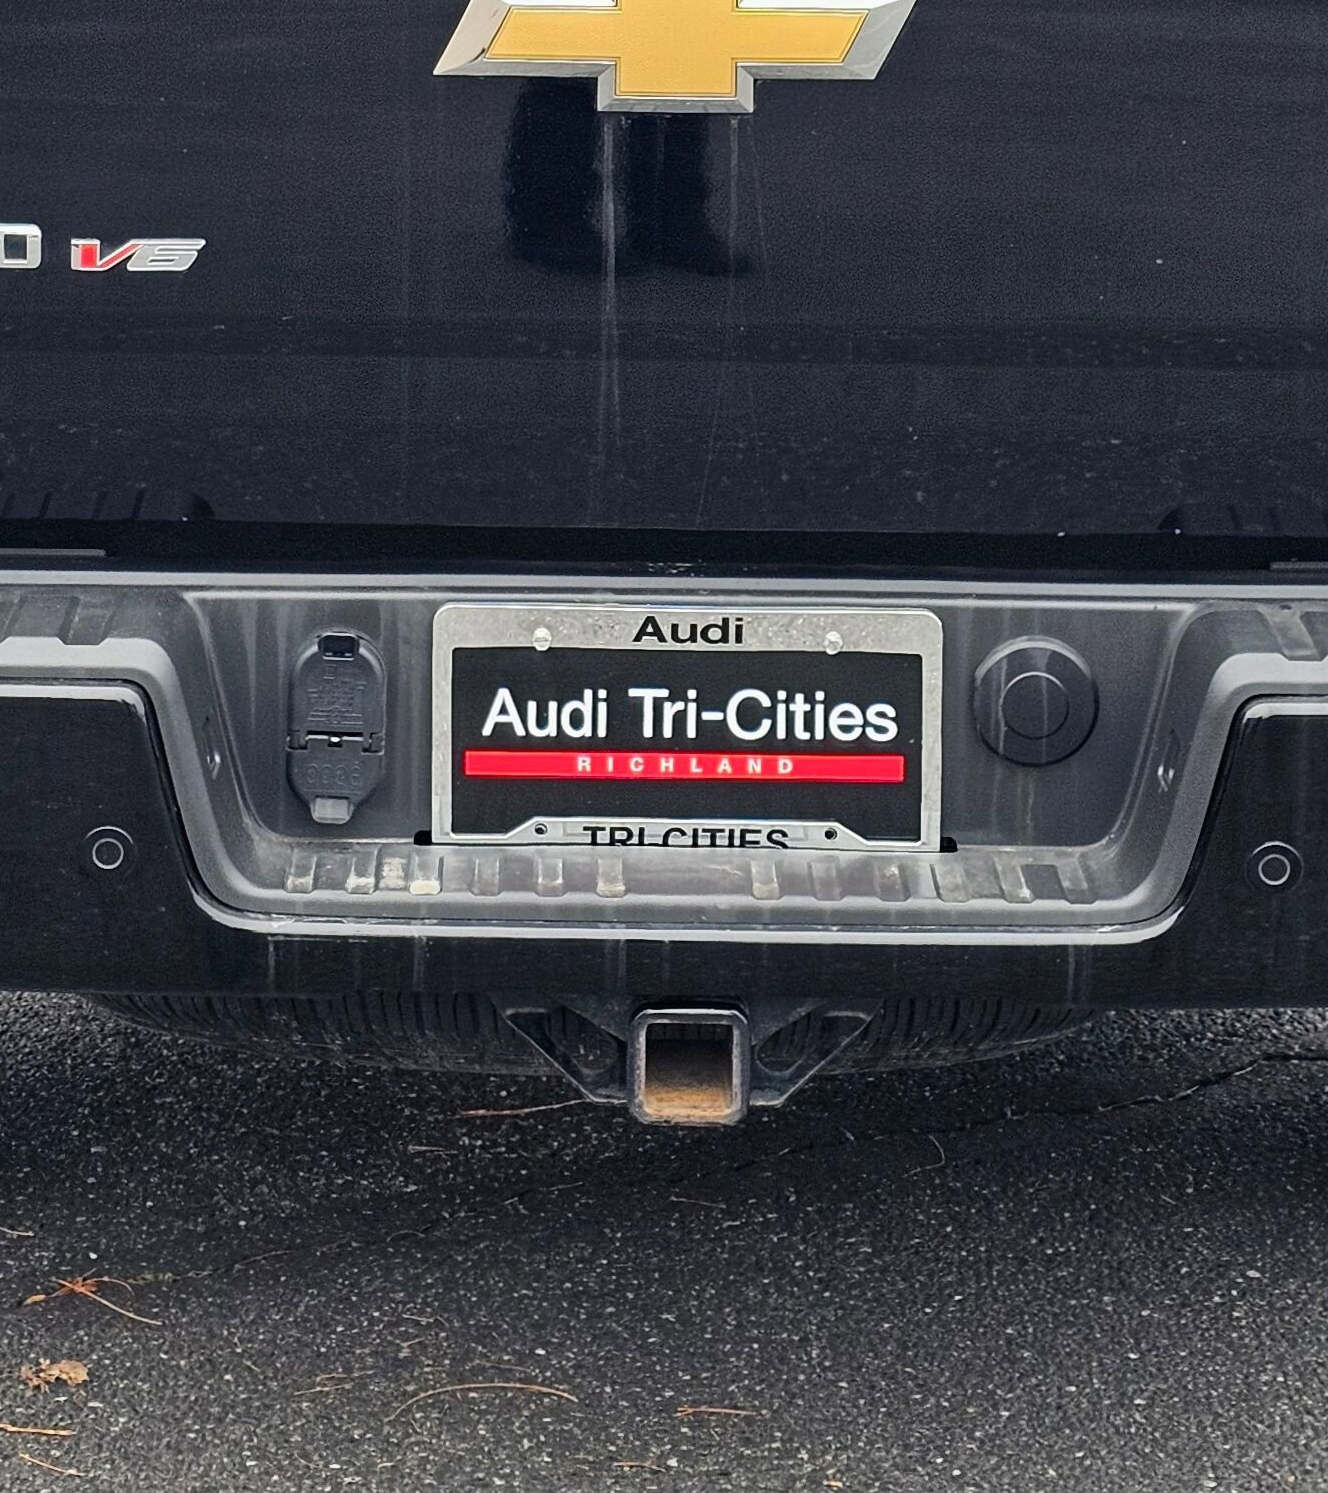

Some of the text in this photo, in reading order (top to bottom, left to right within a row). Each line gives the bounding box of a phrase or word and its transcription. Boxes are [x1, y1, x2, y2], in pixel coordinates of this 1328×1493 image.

[70, 237, 205, 271] V6
[632, 615, 745, 645] Audi
[481, 687, 899, 742] Audi Tri-Cities
[578, 756, 794, 775] RICHLAND
